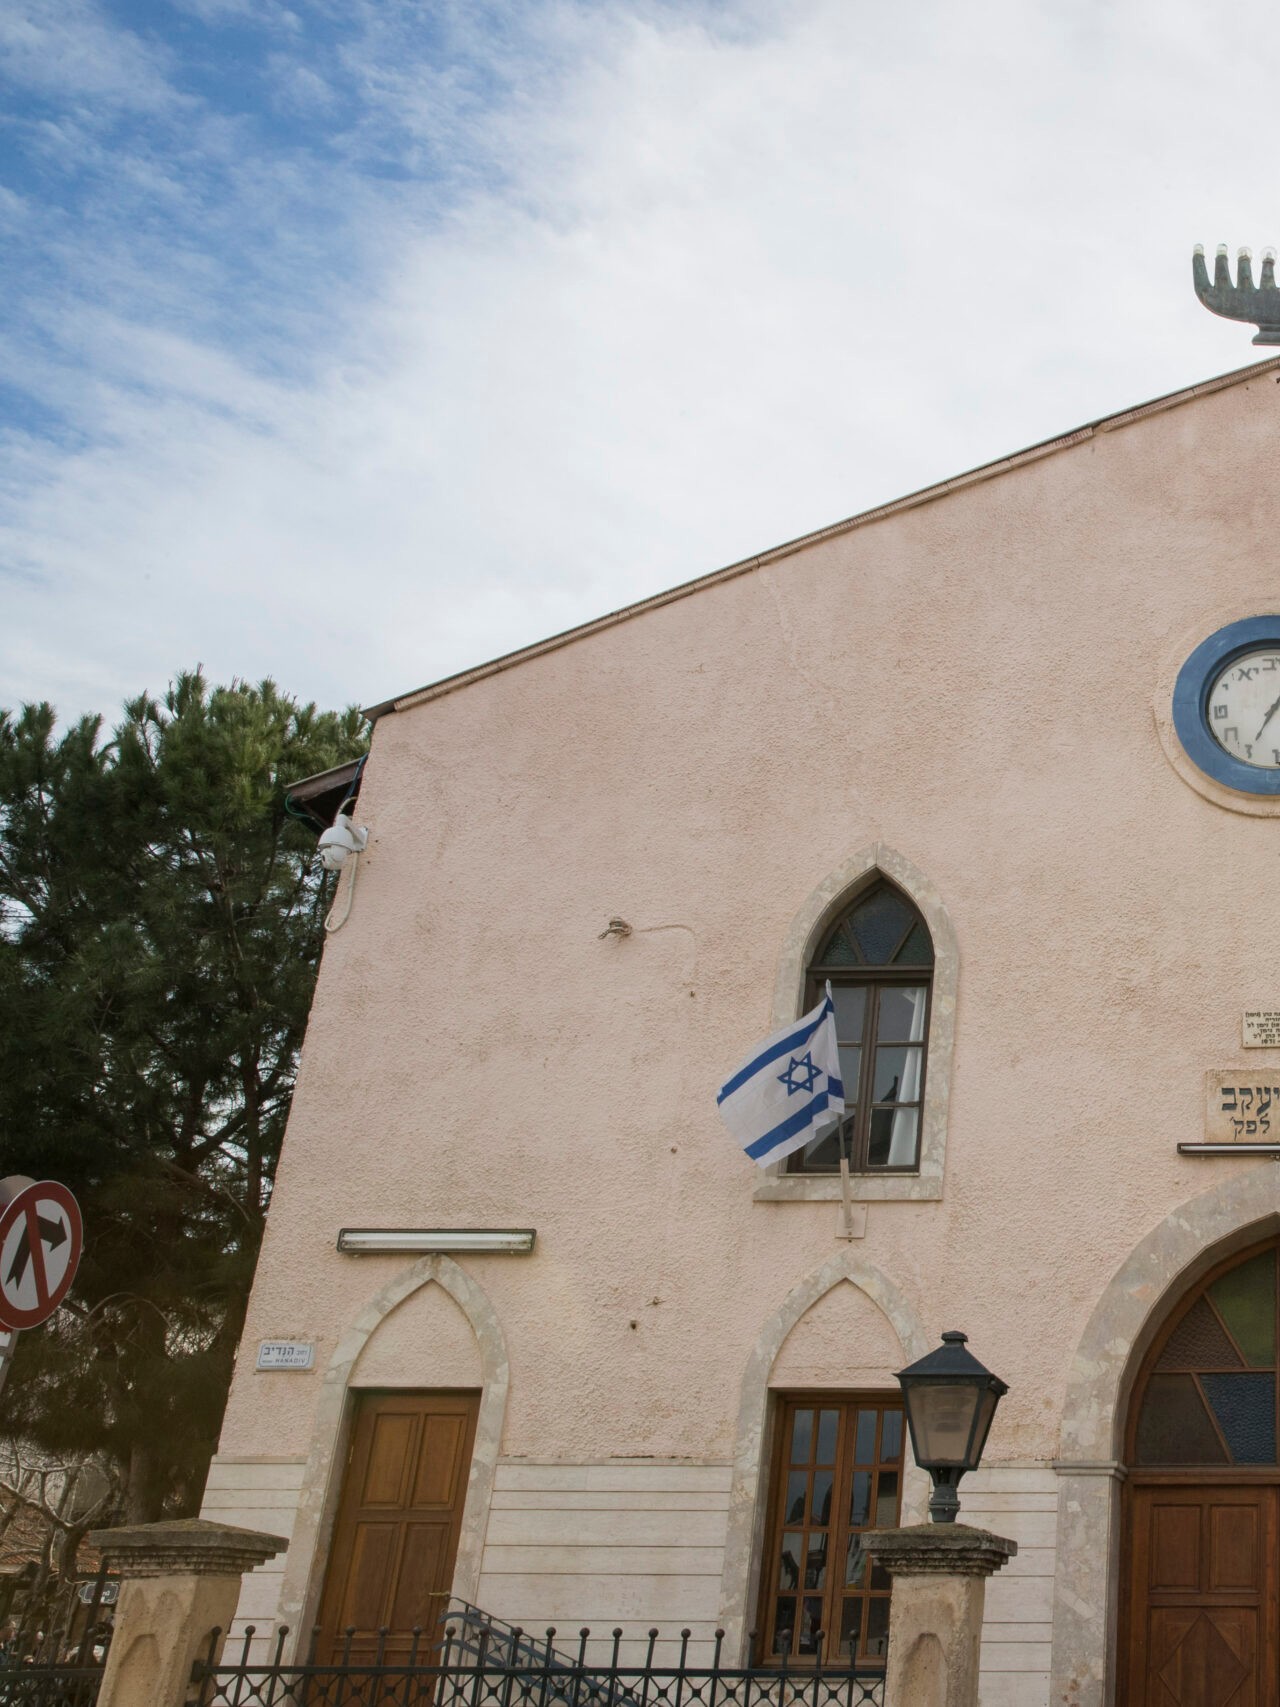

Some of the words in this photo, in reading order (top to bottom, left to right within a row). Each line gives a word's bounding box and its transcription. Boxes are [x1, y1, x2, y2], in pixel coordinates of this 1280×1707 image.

[1238, 667, 1259, 681] יא
[1222, 683, 1229, 691] י
[1214, 704, 1228, 720] ט
[1224, 727, 1238, 742] ח
[1245, 744, 1253, 759] ז
[1221, 1087, 1280, 1116] יעקב
[263, 1346, 295, 1356] הנדיב
